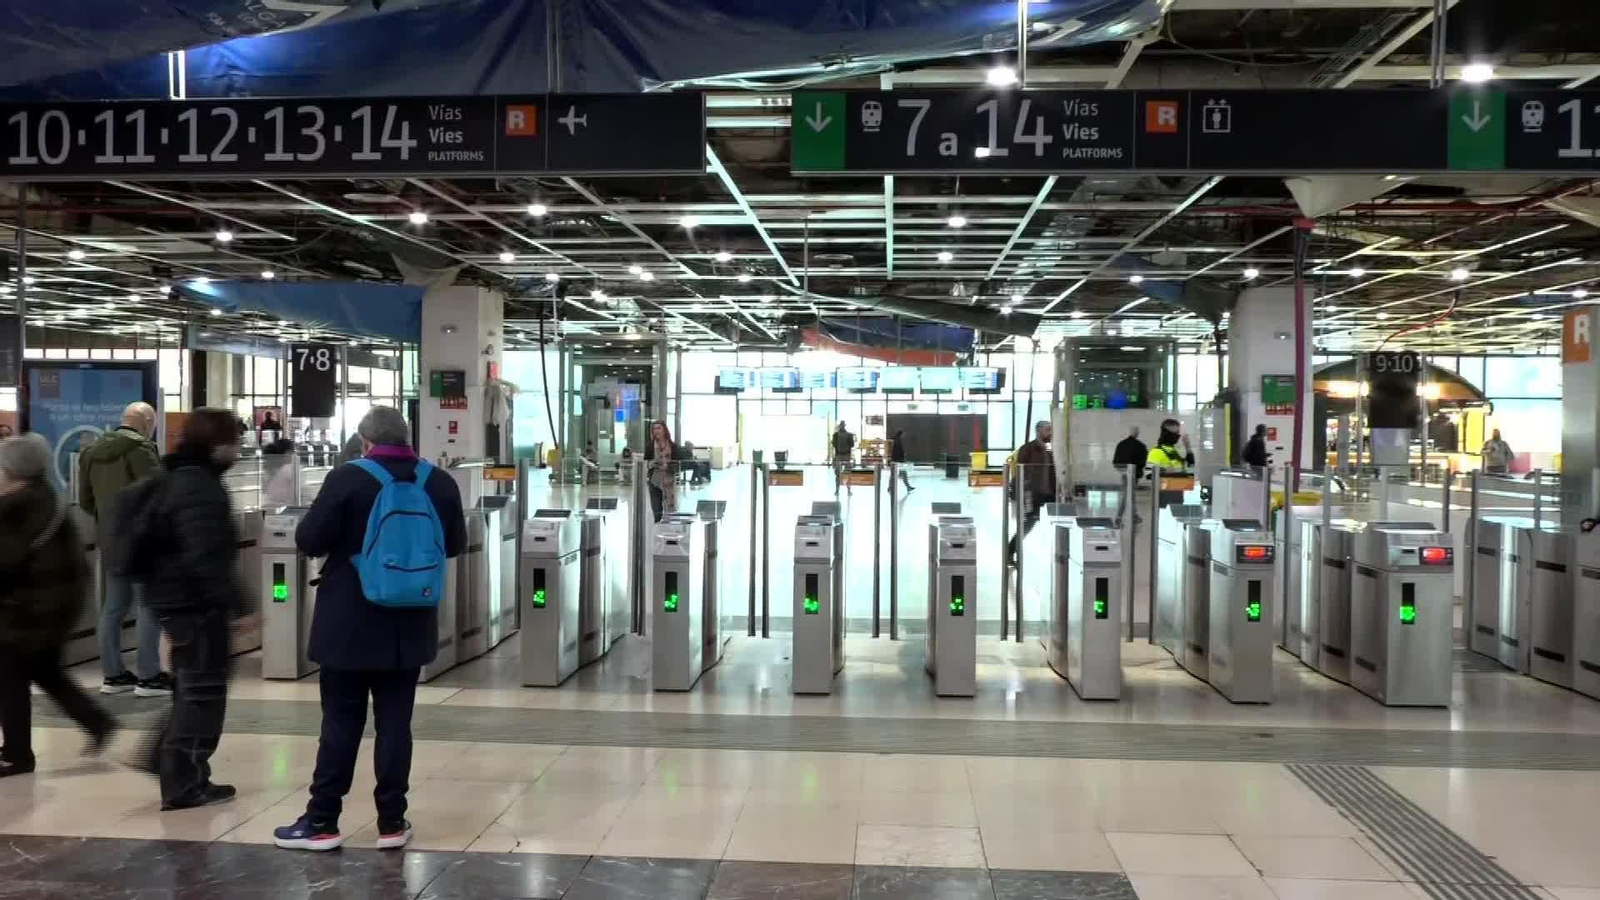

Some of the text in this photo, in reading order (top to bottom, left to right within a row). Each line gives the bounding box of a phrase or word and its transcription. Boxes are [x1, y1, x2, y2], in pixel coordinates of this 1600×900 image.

[428, 104, 462, 120] Vías
[1063, 99, 1099, 116] Vías
[1158, 106, 1175, 126] R
[508, 110, 525, 129] R
[898, 99, 1053, 157] 7 a 14
[1558, 99, 1600, 157] 1
[428, 127, 463, 143] Vies
[1063, 123, 1099, 140] Vies
[428, 150, 484, 161] PLATFORMS
[1062, 147, 1123, 159] PLATFORMS
[1573, 315, 1590, 345] R
